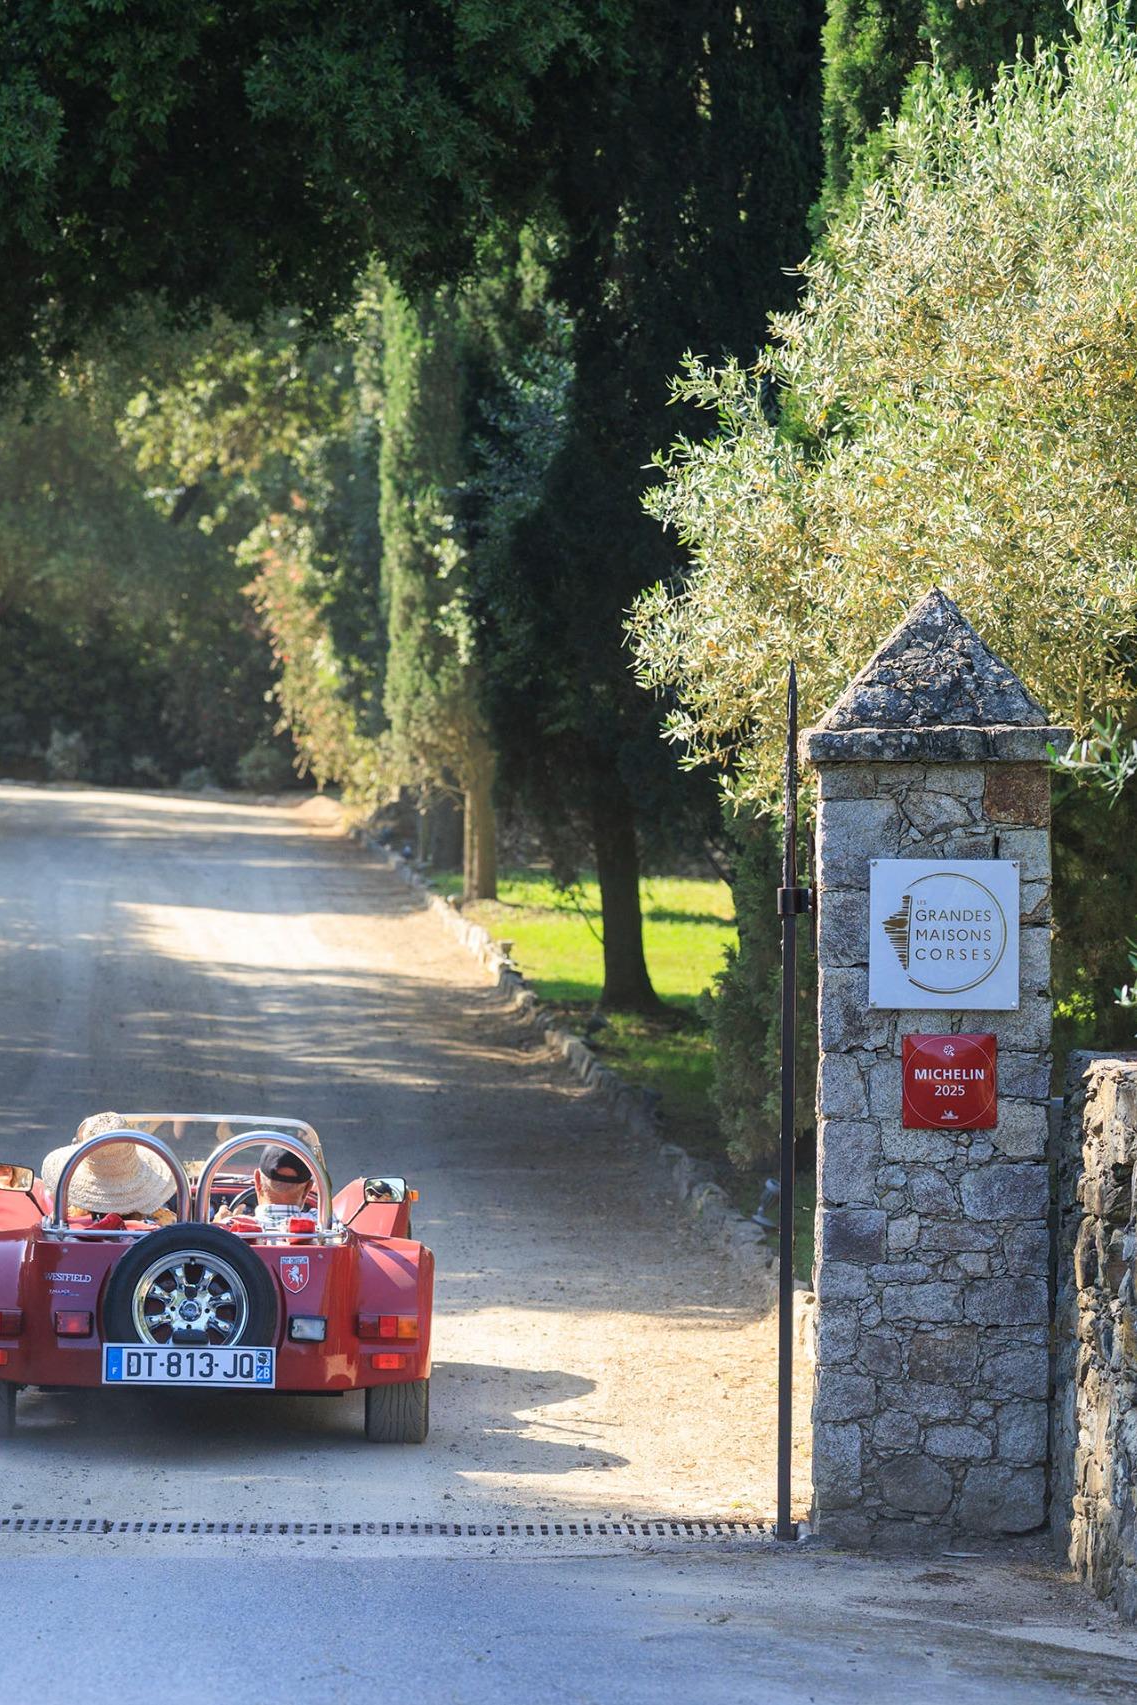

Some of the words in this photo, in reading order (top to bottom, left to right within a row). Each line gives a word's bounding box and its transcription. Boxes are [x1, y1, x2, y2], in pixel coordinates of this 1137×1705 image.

[915, 909, 992, 922] GRANDES
[916, 929, 992, 942] MAISONS
[915, 948, 992, 961] CORSES
[914, 1068, 985, 1080] MICHELIN
[934, 1085, 966, 1096] 2025
[45, 1271, 92, 1283] WESTFIELD
[111, 1366, 118, 1375] F
[126, 1351, 254, 1379] DT-813-JQ
[256, 1366, 270, 1379] 2B
